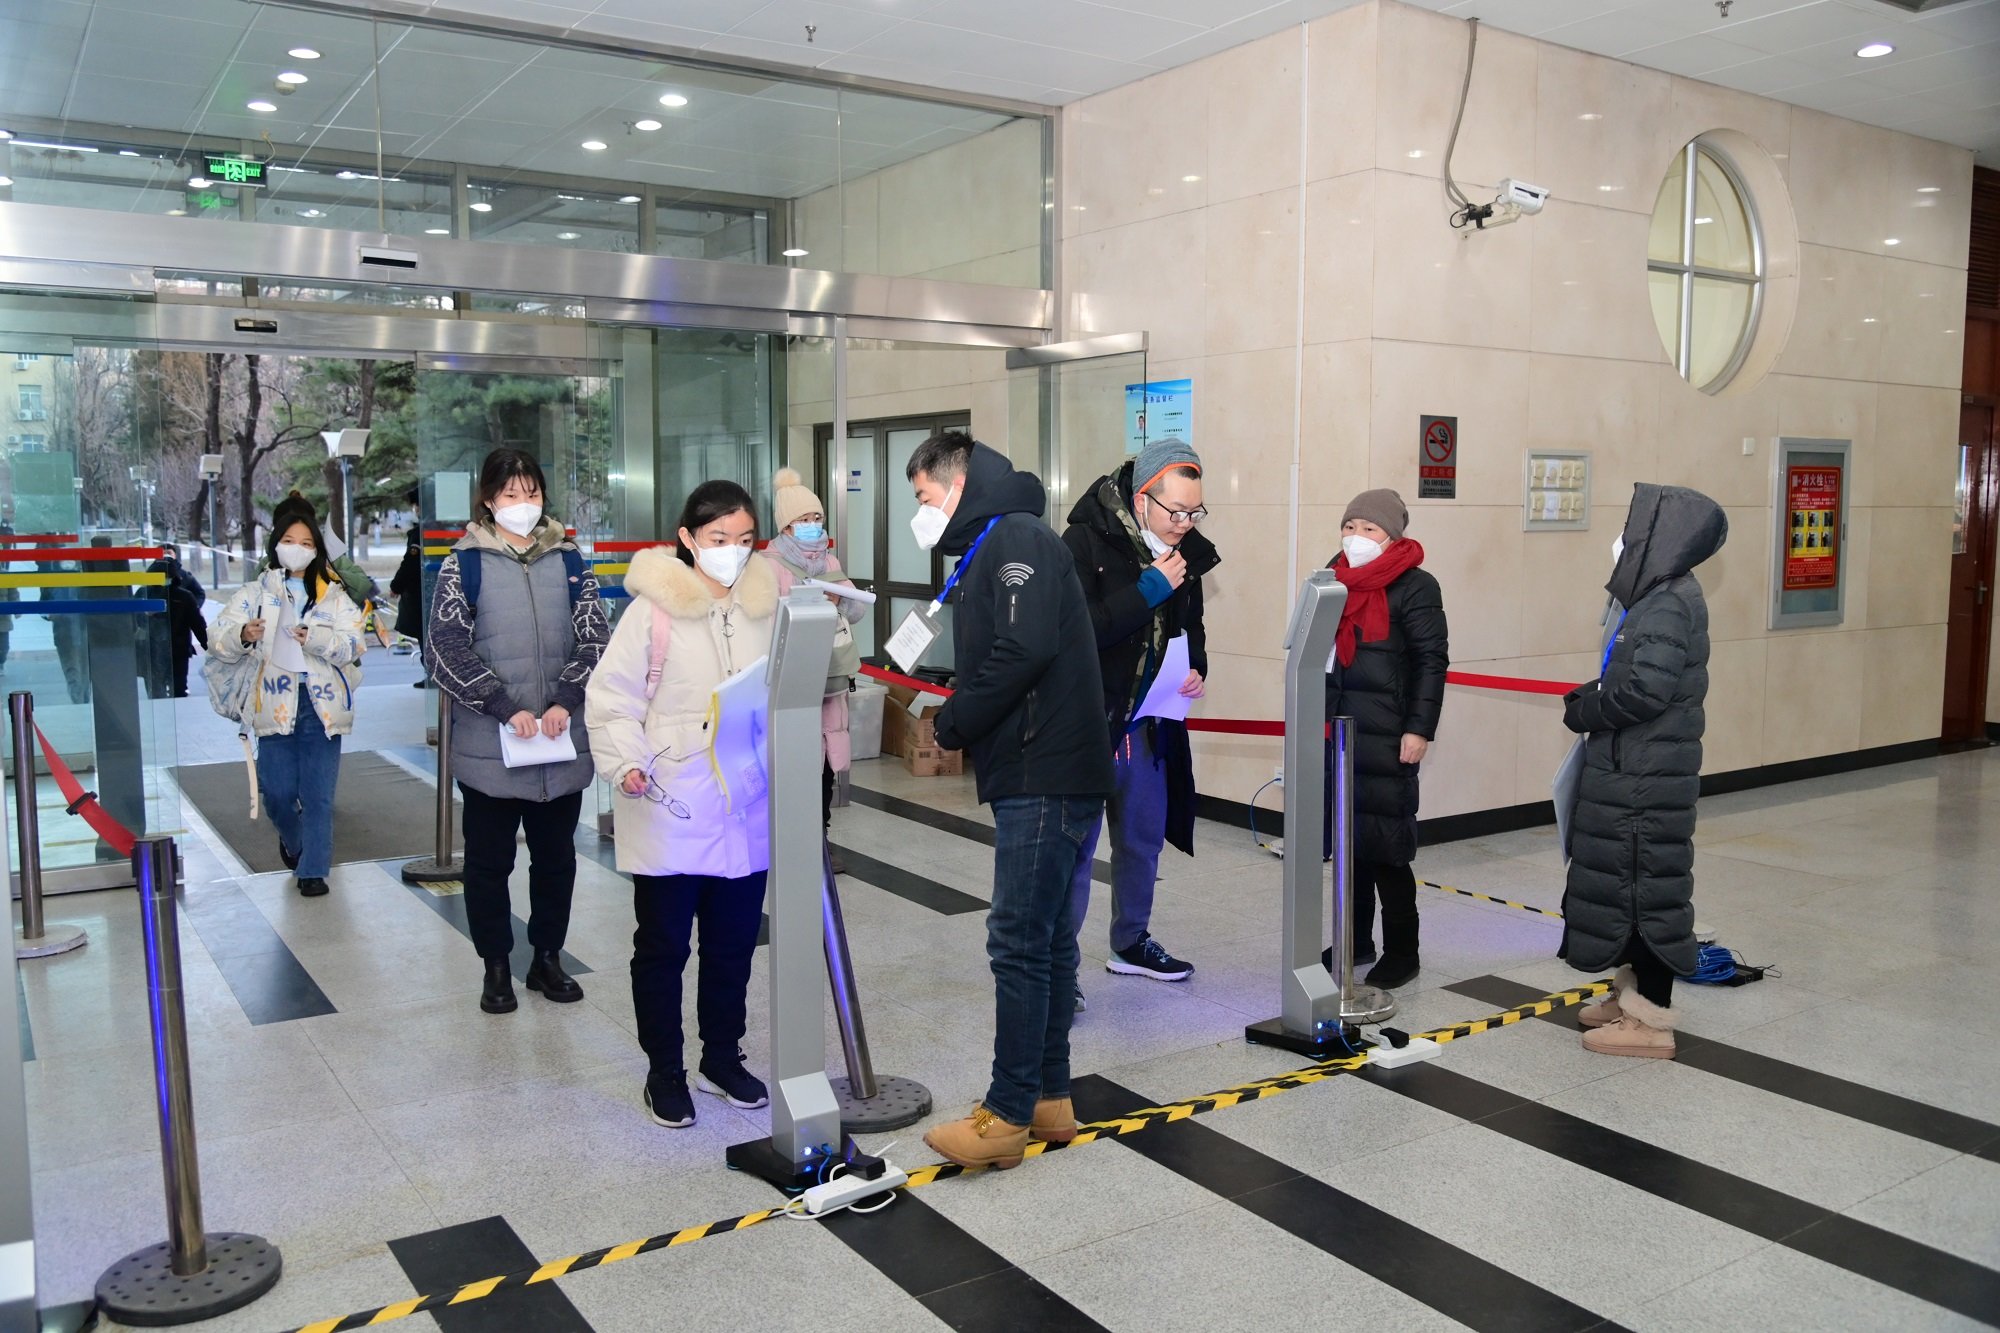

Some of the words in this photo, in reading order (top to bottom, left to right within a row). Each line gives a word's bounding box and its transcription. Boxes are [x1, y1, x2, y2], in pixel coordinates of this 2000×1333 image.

[246, 168, 261, 177] EXIT
[1423, 467, 1454, 477] 禁止吸烟
[1431, 479, 1452, 487] SMOKING
[1802, 474, 1824, 486] 消火栓
